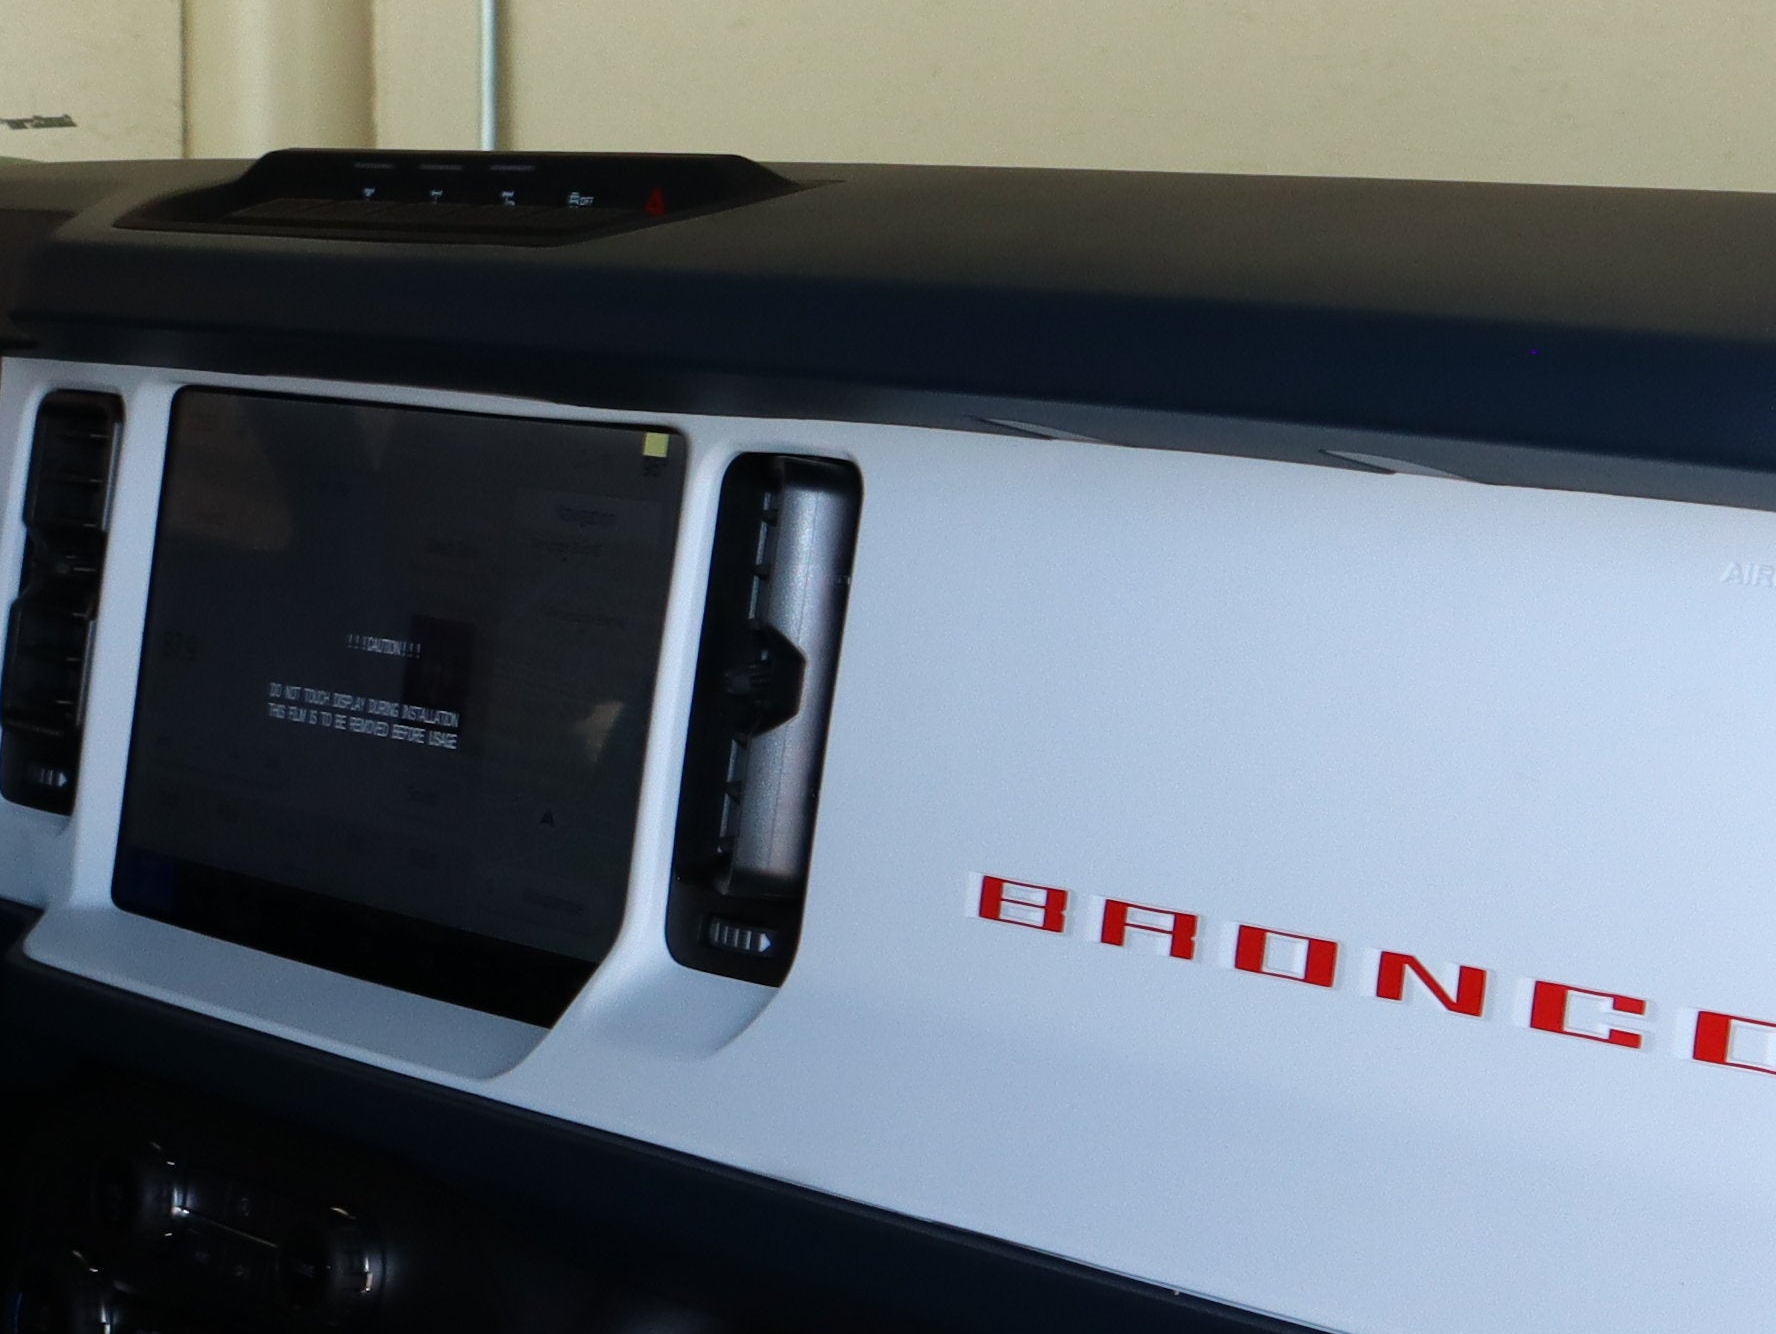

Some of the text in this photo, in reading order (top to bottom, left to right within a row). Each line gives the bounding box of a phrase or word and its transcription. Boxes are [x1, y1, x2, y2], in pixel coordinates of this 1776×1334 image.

[268, 702, 458, 750] THIS FILM IS TO BE REMOVED BEFORE USAGE
[270, 682, 460, 728] DO NOT TOUCH DISPLAY DURING INSTALLATION
